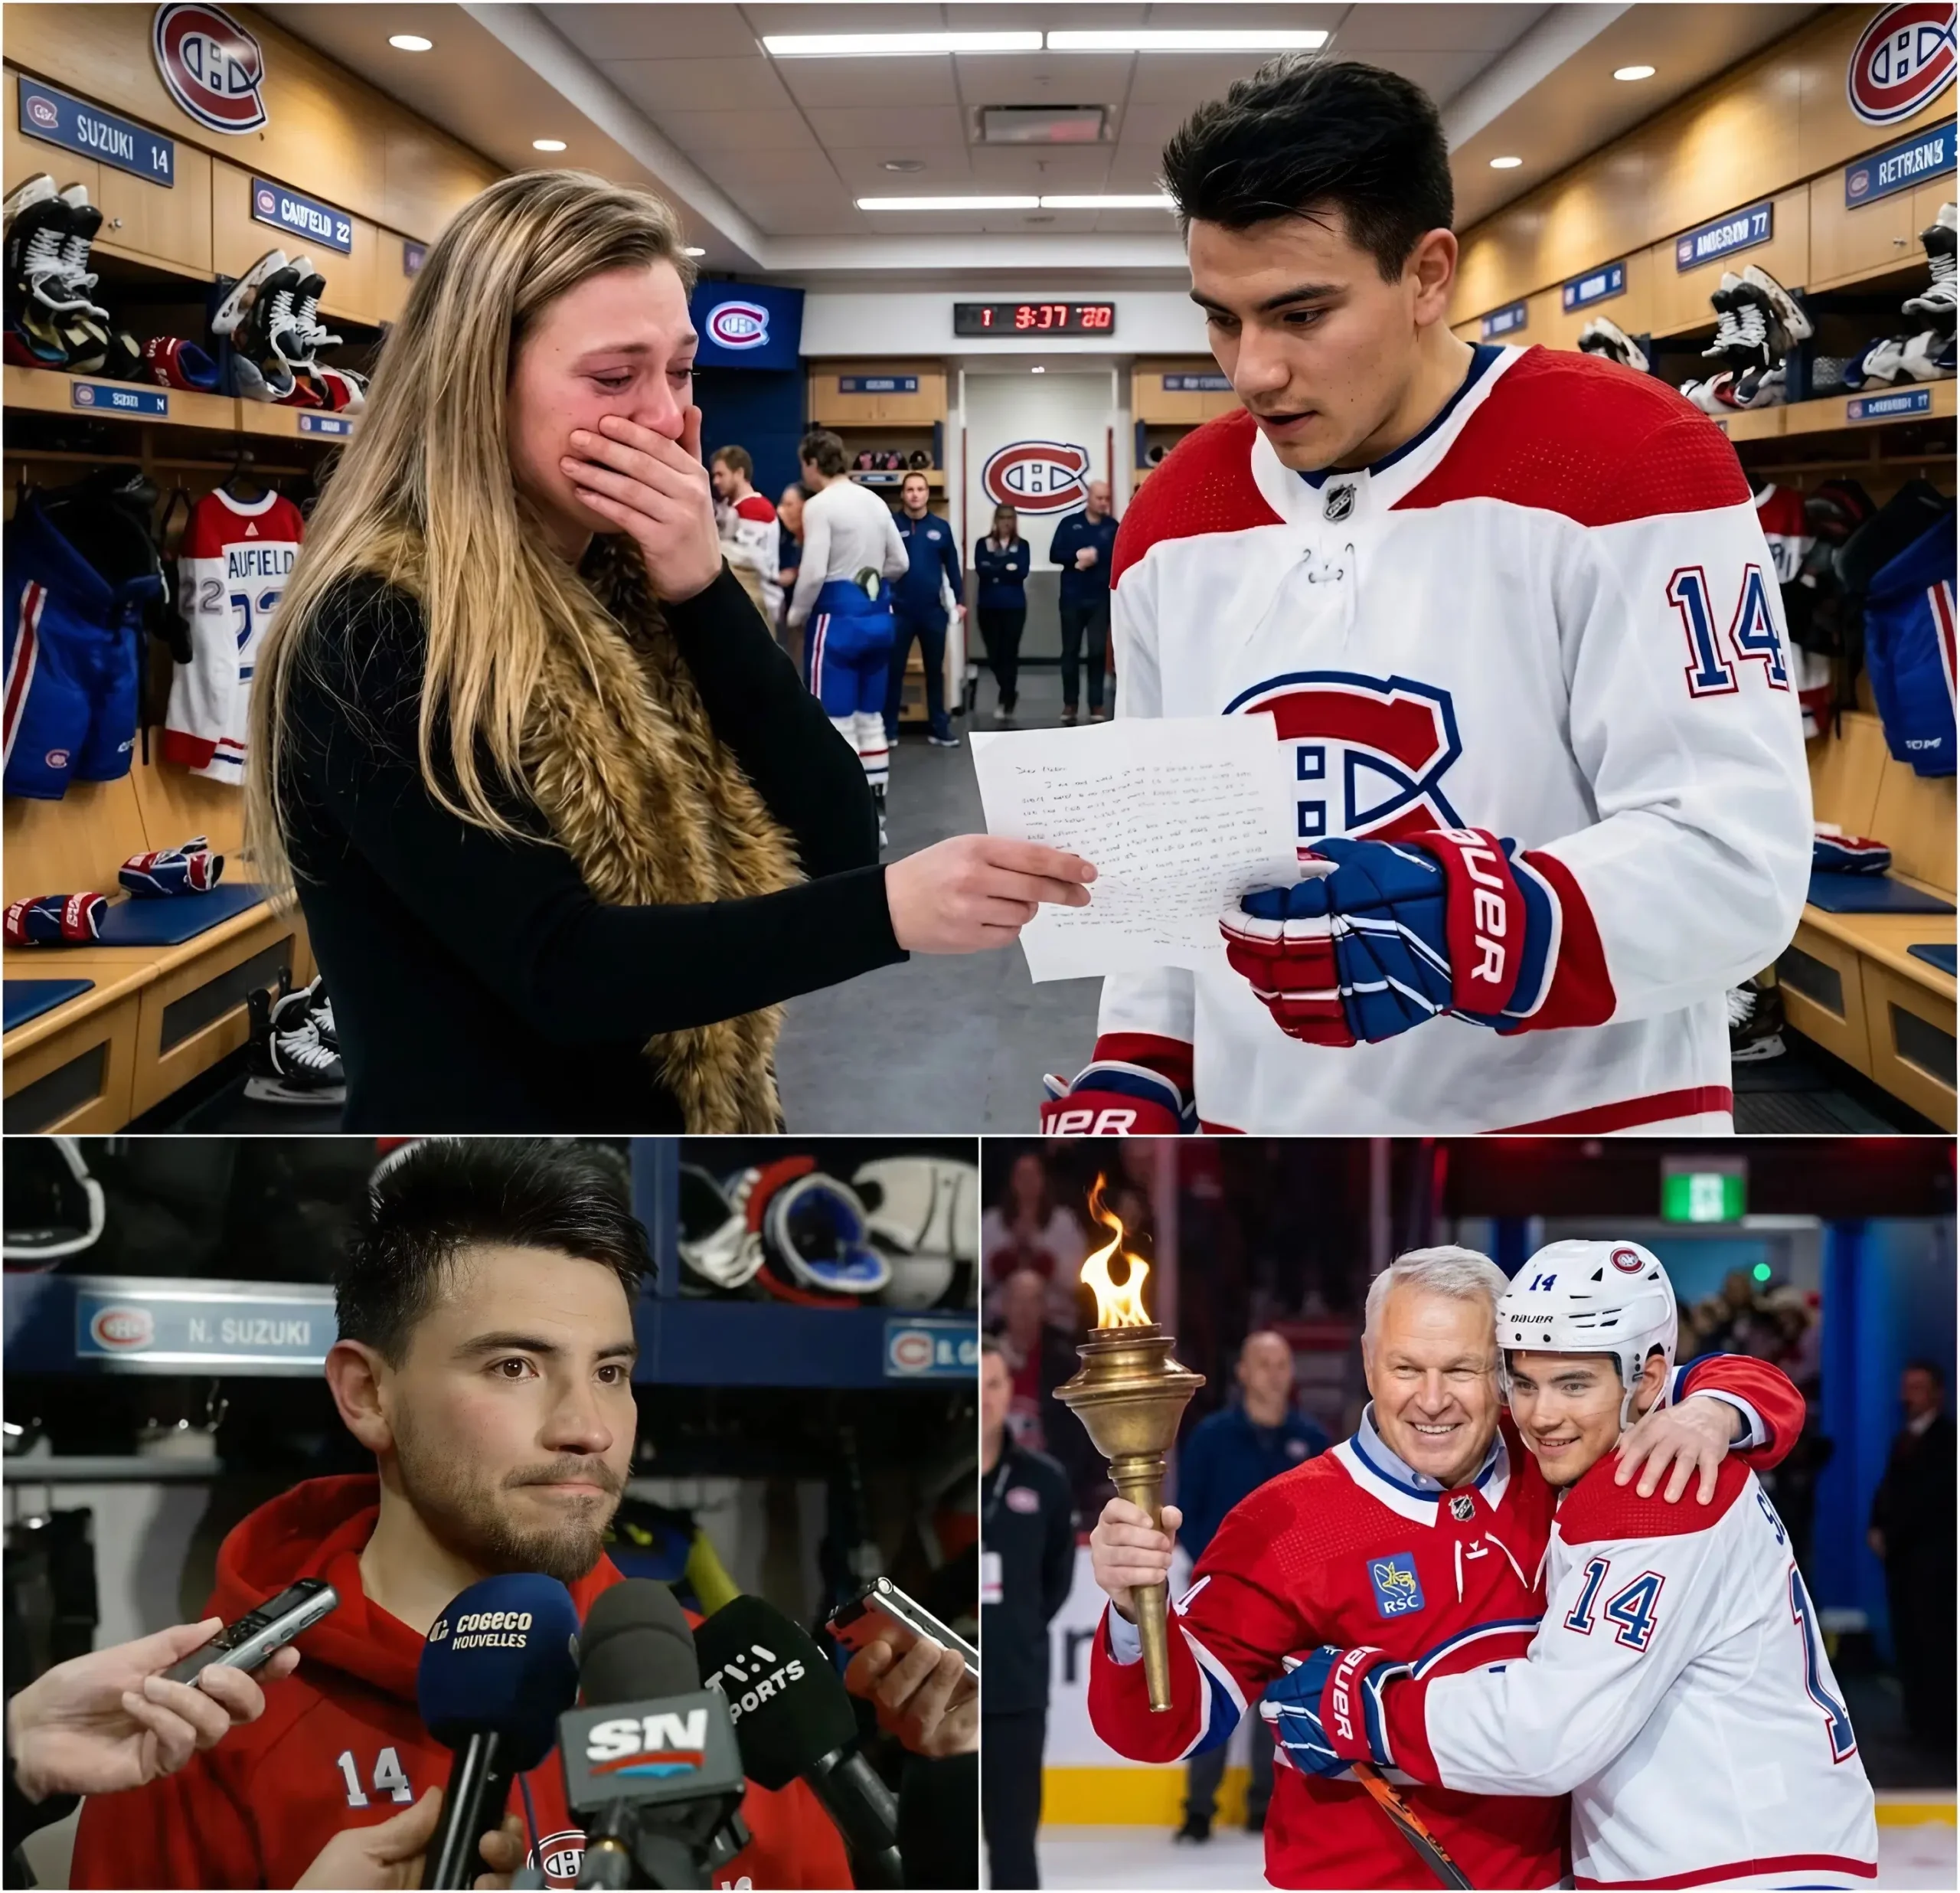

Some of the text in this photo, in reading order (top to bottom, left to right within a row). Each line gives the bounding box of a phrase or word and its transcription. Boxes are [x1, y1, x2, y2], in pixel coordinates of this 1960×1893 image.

[77, 115, 168, 173] SUZUKI 14
[1752, 211, 1767, 236] 77
[228, 549, 296, 580] AUFIELD
[1665, 563, 1790, 698] 14
[1529, 1273, 1557, 1292] 14
[189, 1317, 213, 1343] N.
[221, 1318, 311, 1345] SUZUKI
[1383, 1594, 1419, 1614] RSC
[1563, 1557, 1666, 1653] 14
[456, 1611, 533, 1633] COGECO
[452, 1633, 528, 1650] NOUVELLES
[729, 1659, 805, 1725] PORTS
[586, 1708, 708, 1761] SN
[338, 1747, 413, 1807] 14
